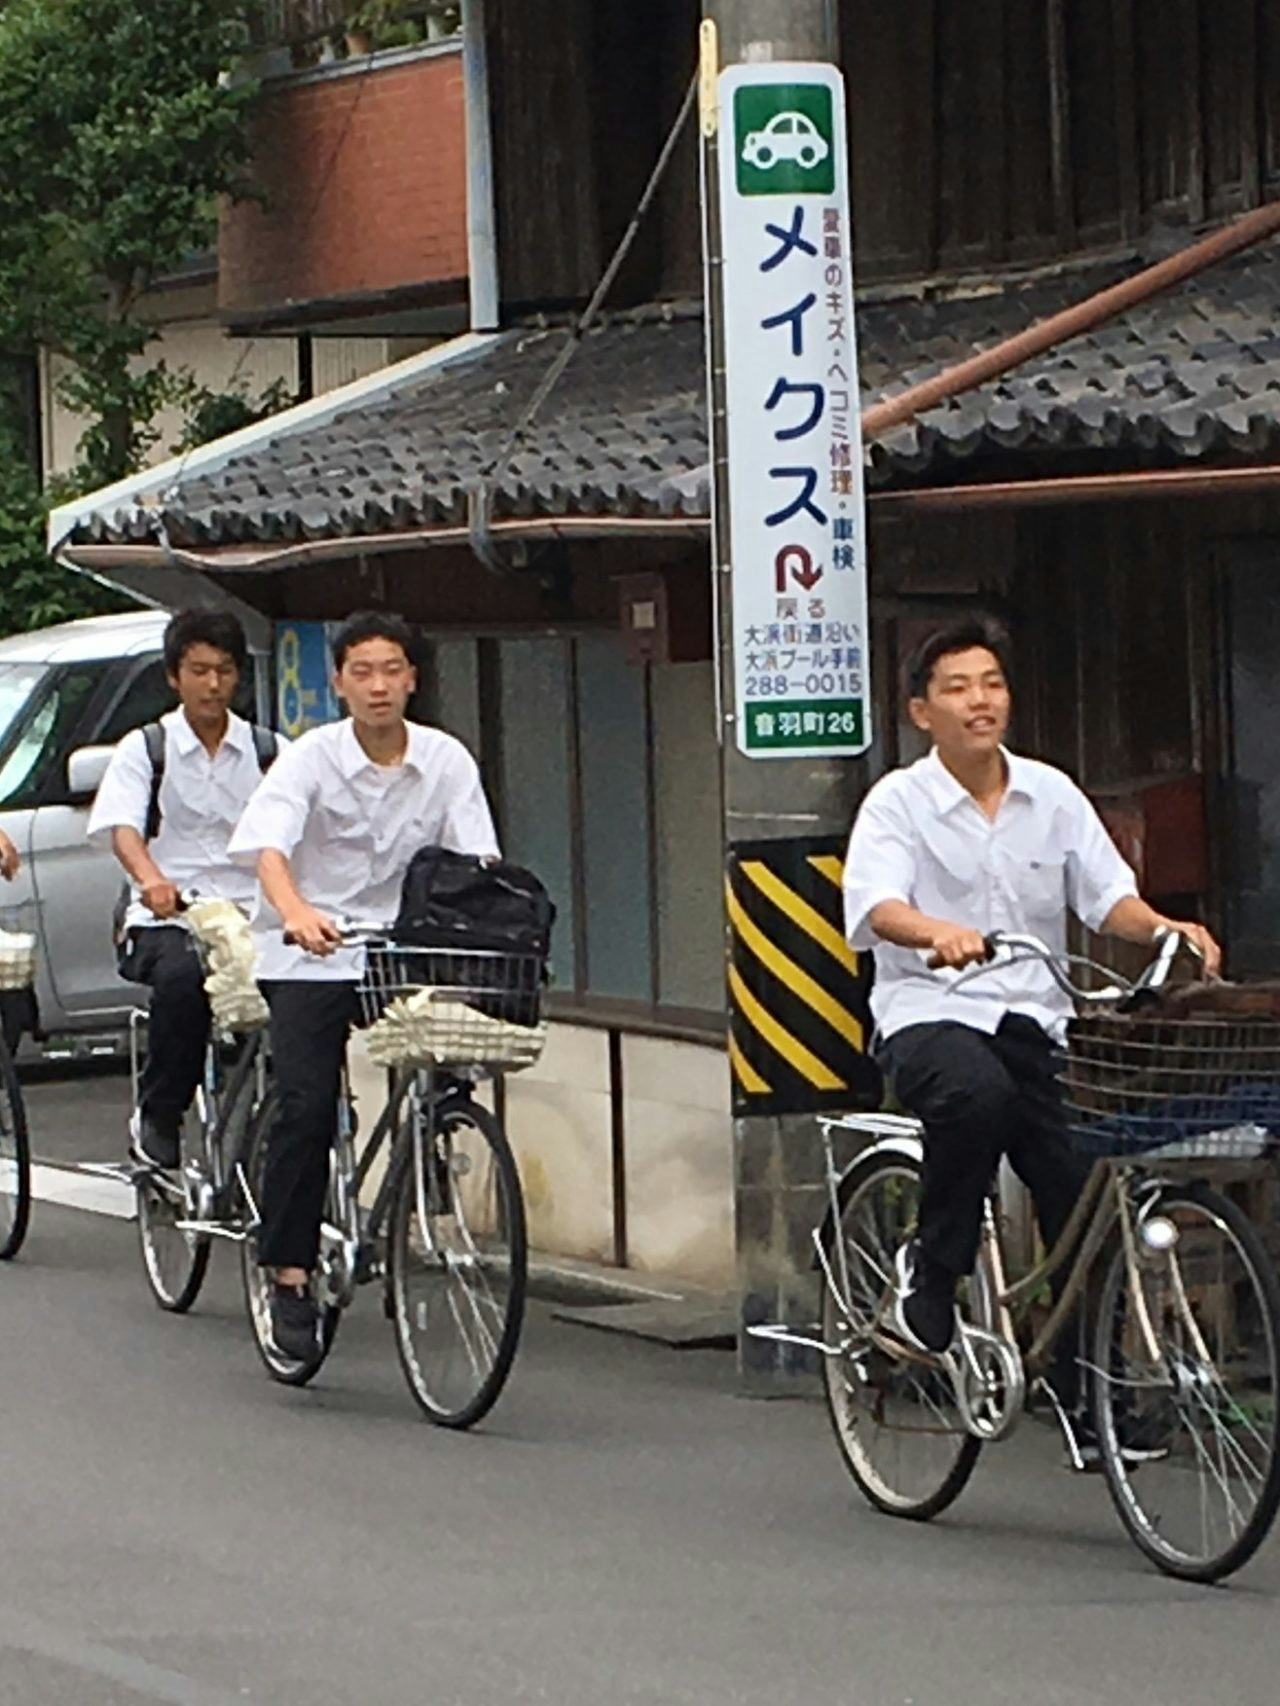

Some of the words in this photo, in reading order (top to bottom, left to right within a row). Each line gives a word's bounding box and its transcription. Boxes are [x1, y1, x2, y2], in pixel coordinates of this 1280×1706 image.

[760, 205, 828, 527] メイクス
[776, 598, 826, 620] 戻る
[745, 672, 863, 696] 288-0015
[754, 711, 856, 737] 音羽町26
